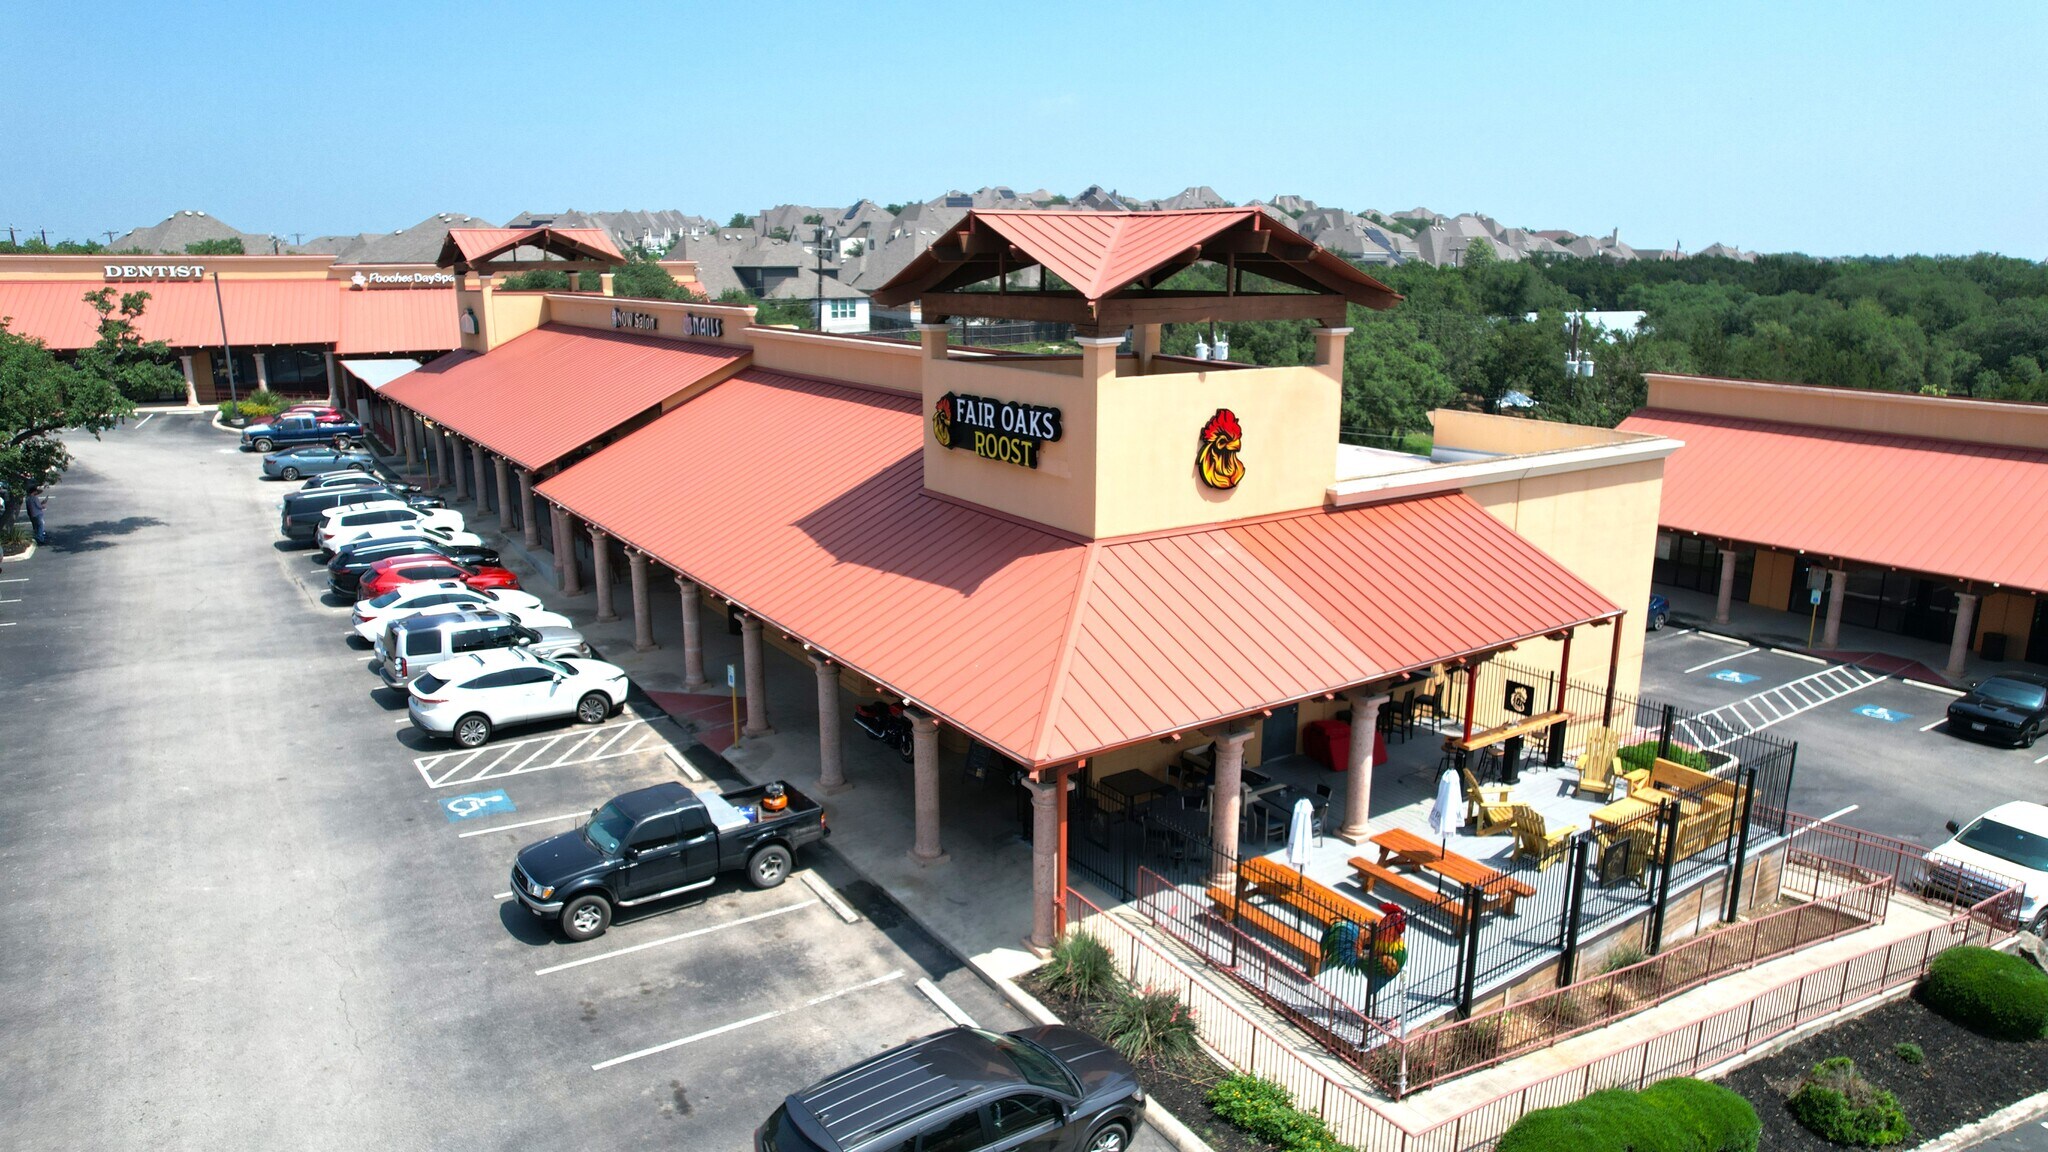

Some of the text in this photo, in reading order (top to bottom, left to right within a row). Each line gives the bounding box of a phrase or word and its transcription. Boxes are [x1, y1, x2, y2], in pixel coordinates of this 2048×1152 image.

[104, 265, 205, 278] DENTIST
[369, 272, 413, 283] Pooches
[692, 316, 721, 337] NAILS
[956, 398, 1055, 439] FAIR OAKS
[974, 431, 1033, 467] ROOST
